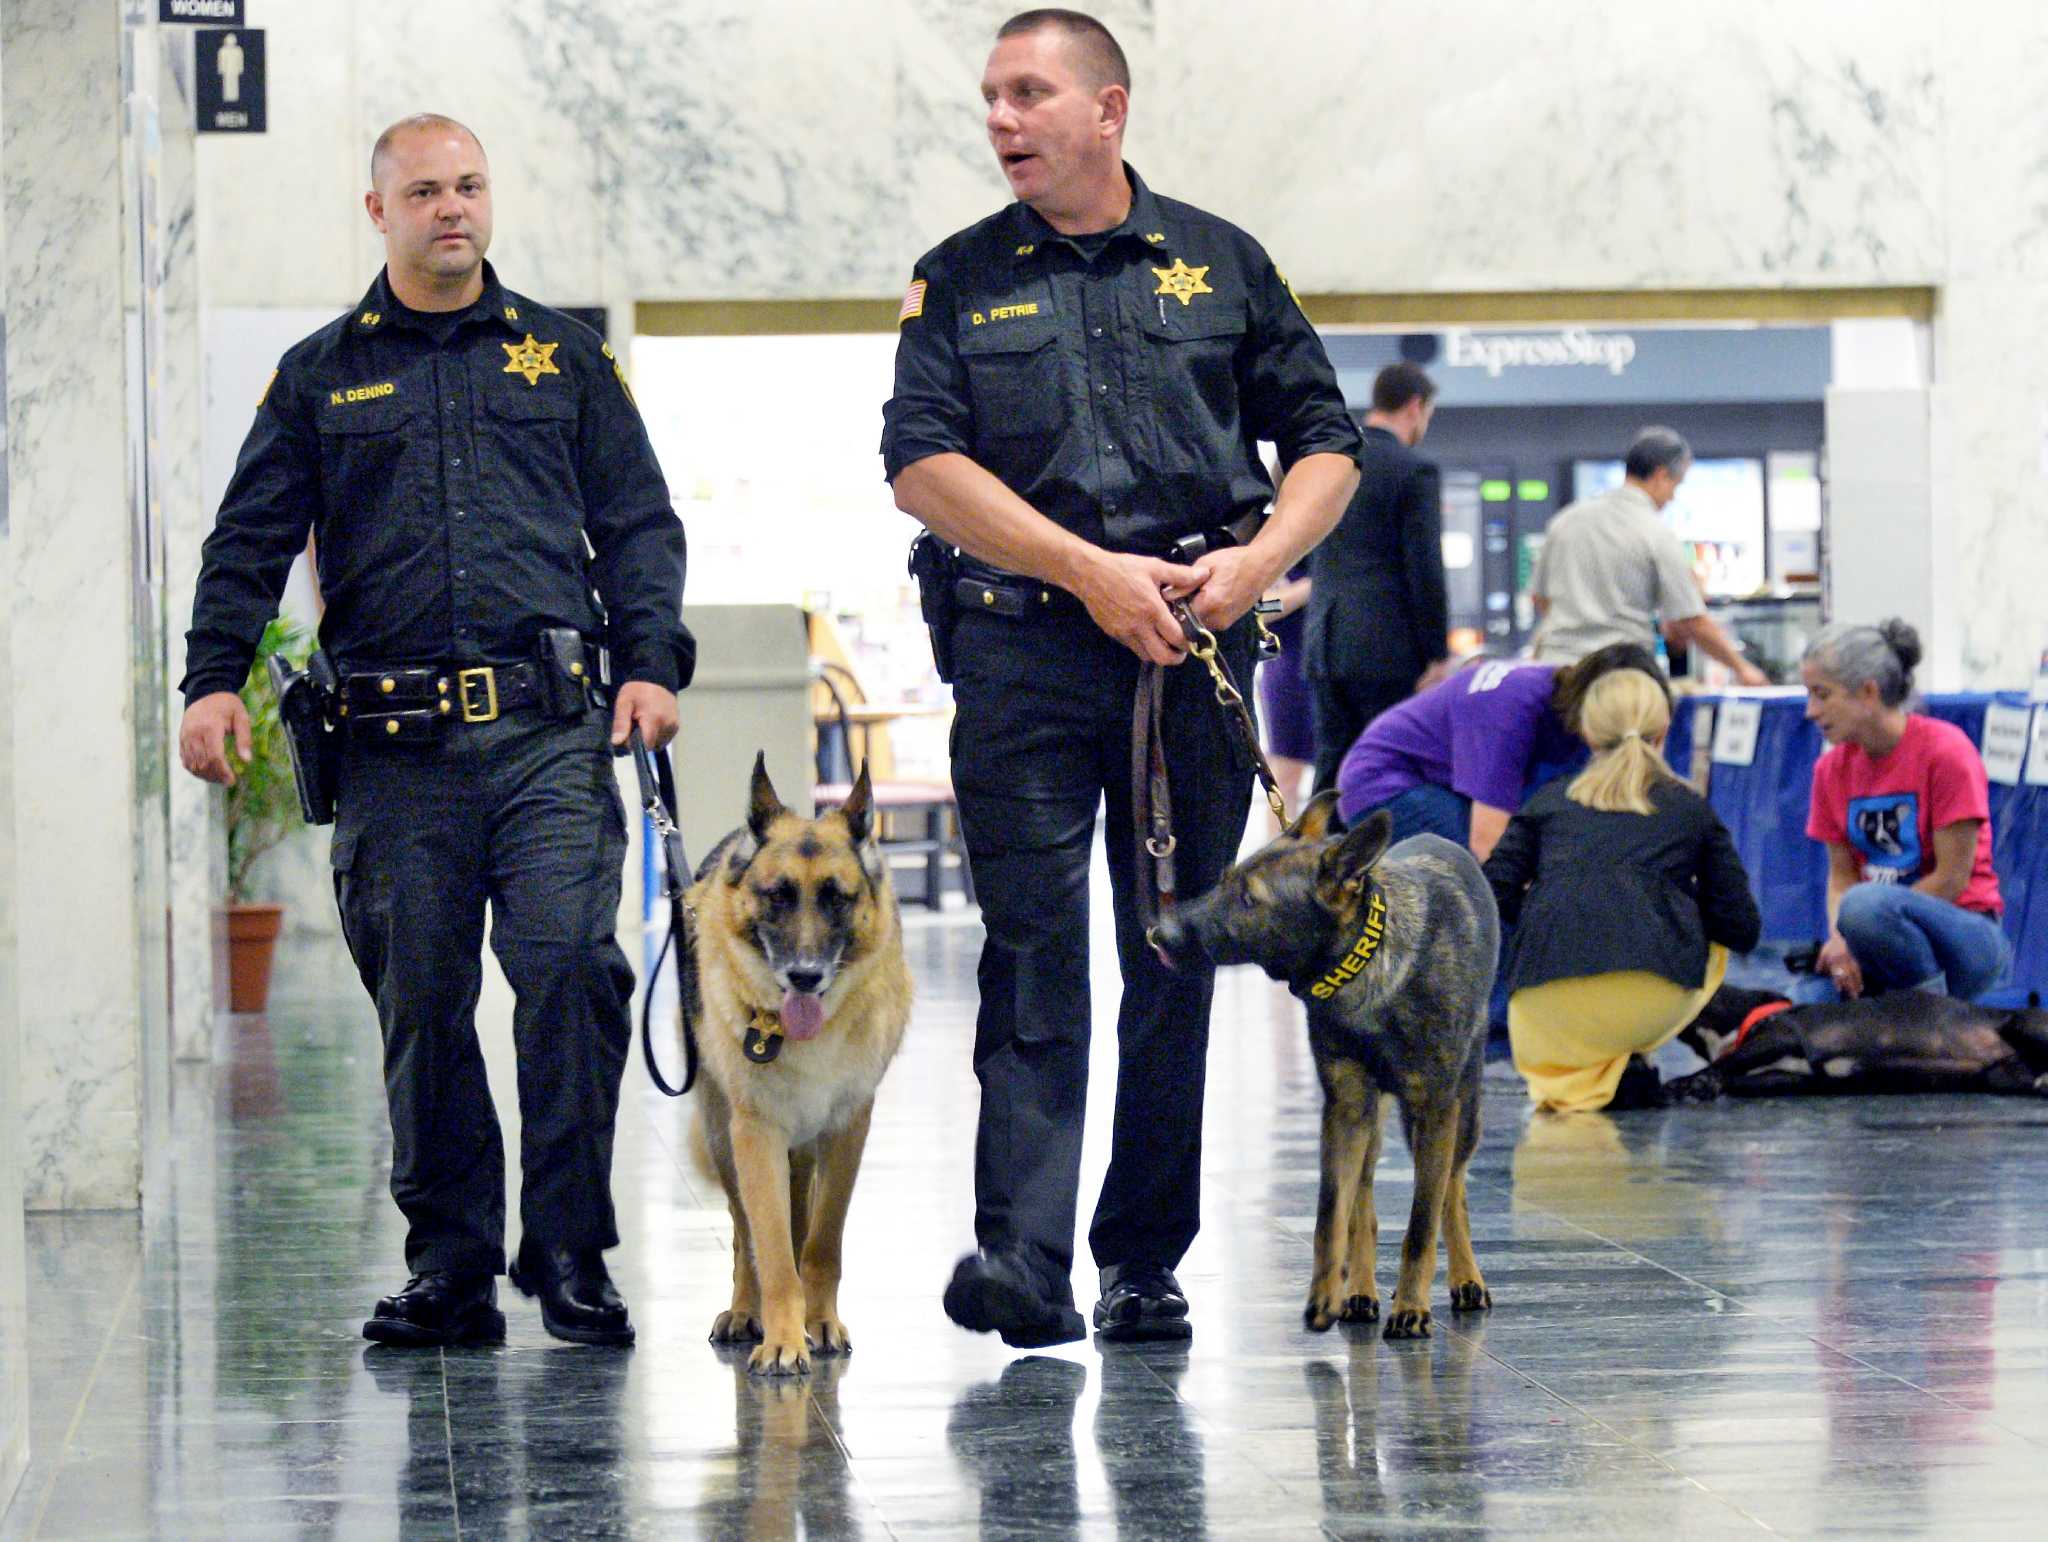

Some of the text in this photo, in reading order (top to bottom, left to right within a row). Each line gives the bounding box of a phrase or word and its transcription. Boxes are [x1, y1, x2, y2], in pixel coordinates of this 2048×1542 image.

[170, 0, 235, 17] WOMEN
[215, 111, 248, 128] MEN
[972, 303, 1039, 325] D. PETRIE
[330, 382, 394, 405] N. DENNO
[1311, 893, 1386, 999] SHERIFF
